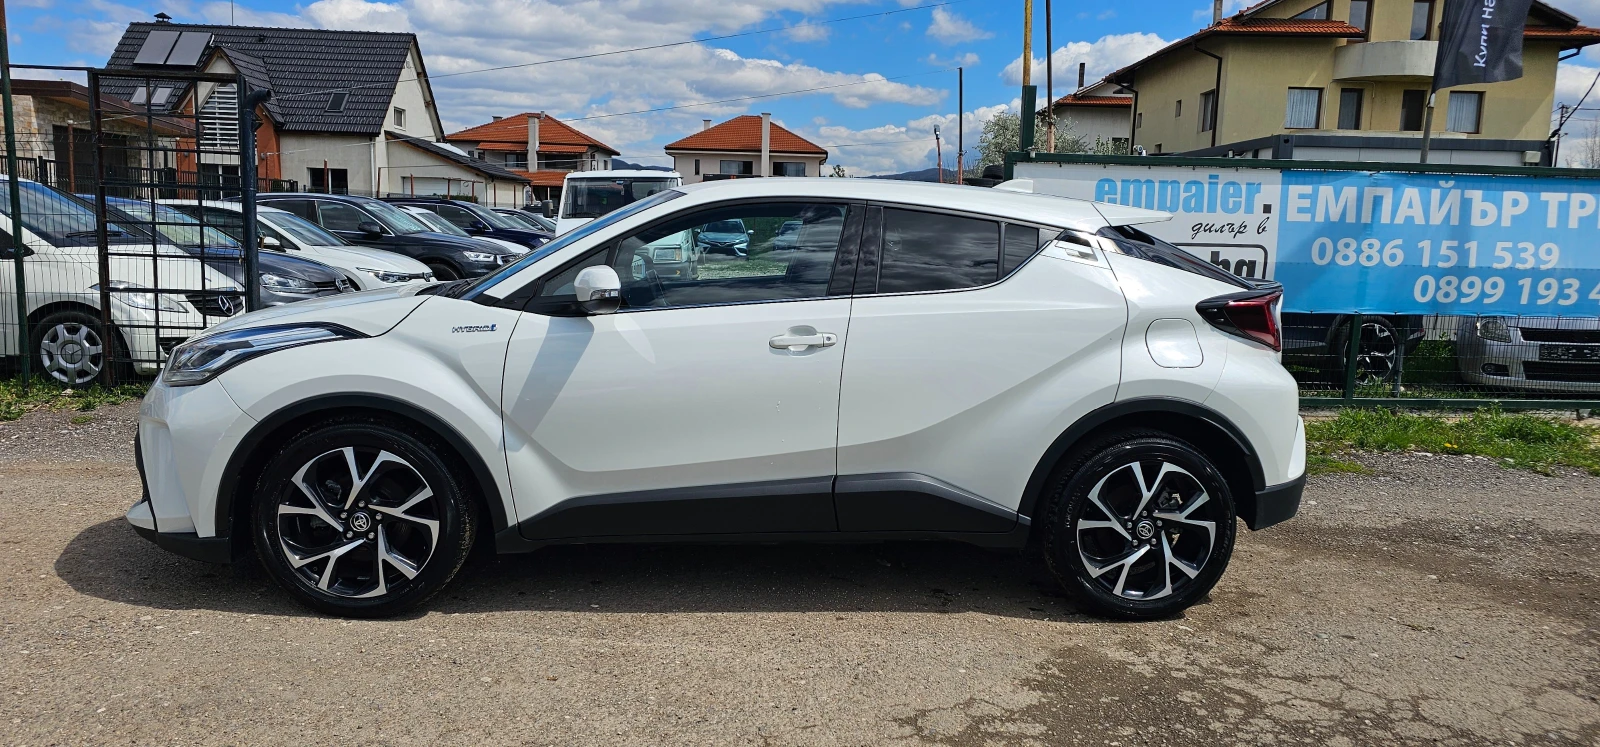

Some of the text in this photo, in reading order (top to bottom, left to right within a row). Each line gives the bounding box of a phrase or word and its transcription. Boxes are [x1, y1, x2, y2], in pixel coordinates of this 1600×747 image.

[1474, 24, 1490, 67] Купи
[1286, 180, 1600, 229] ЕМПАЙЪР ТР
[1191, 220, 1248, 239] дилър
[1311, 237, 1560, 270] 0886 151 539
[1413, 275, 1505, 304] 0899
[1517, 277, 1580, 306] 193
[452, 324, 490, 333] HYBRID
